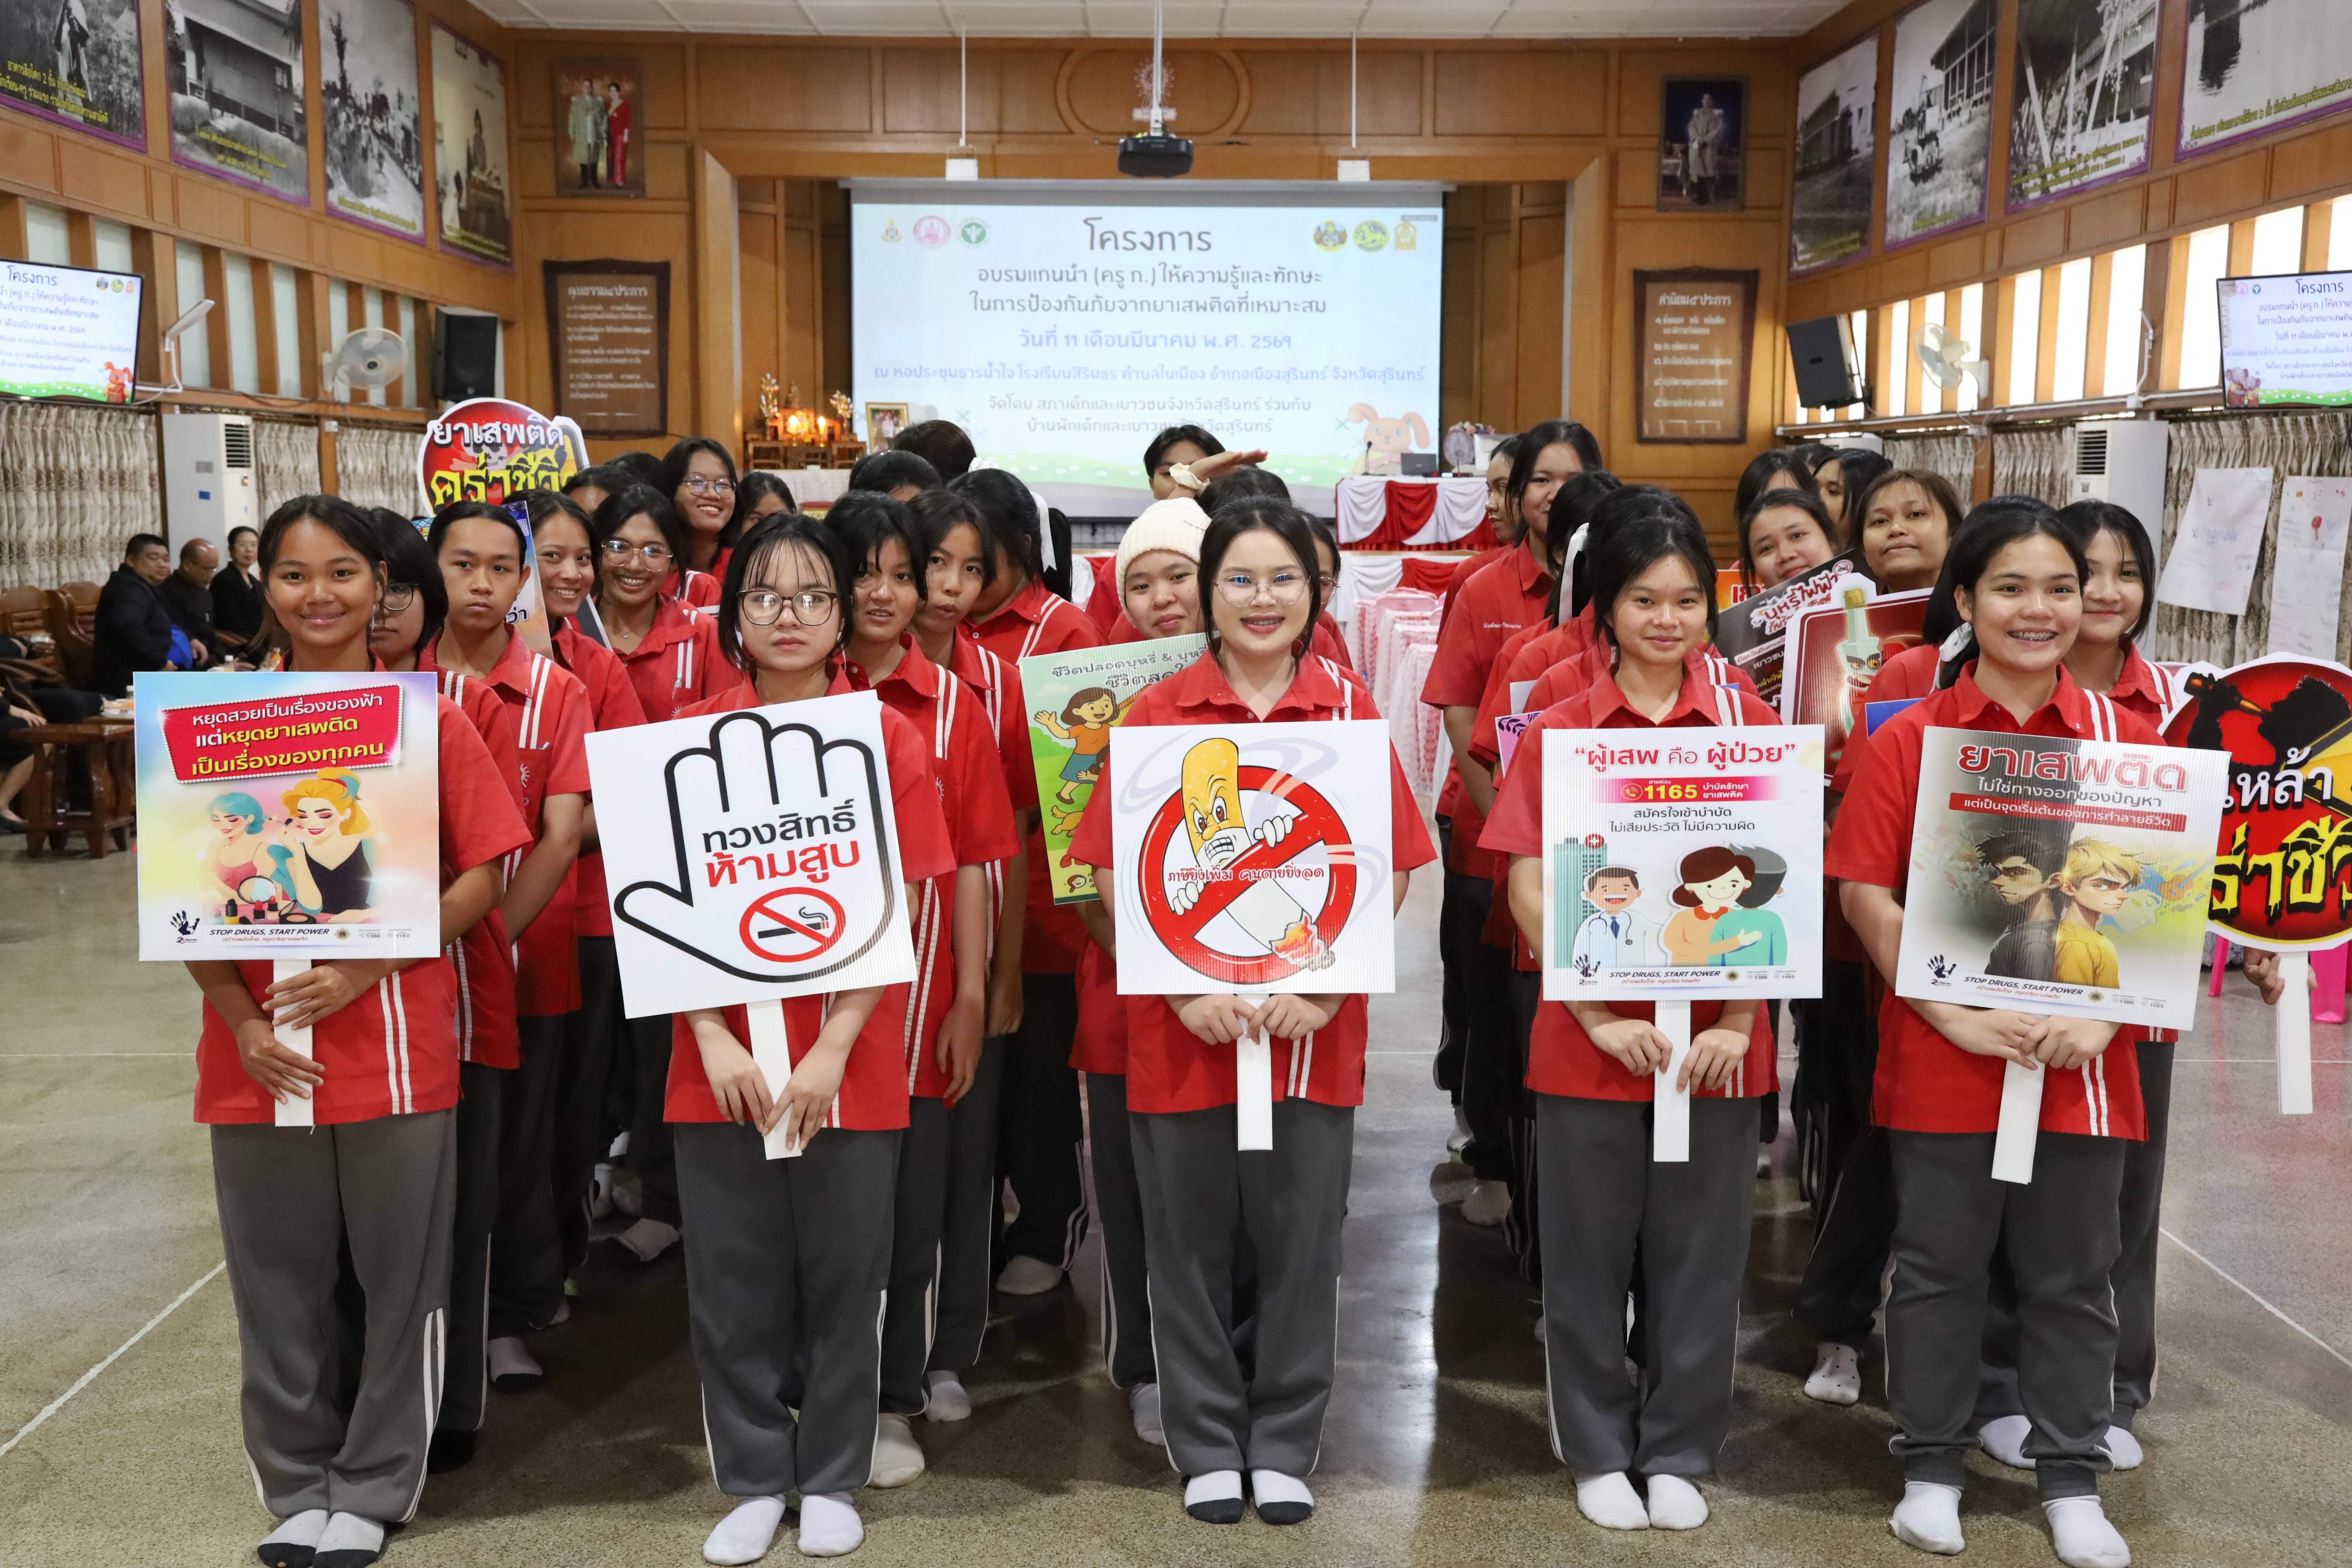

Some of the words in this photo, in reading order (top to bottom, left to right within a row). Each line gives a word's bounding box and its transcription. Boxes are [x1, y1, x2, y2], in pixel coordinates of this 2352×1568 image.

[1083, 217, 1212, 251] โครงการ
[8, 265, 58, 286] โครงการ
[978, 263, 1087, 283] อบรมแกนนำ
[1094, 267, 1125, 288] (ครู
[1158, 262, 1322, 290] ให้ความรู้และทักษะ
[2295, 279, 2344, 294] โครงการ
[970, 289, 1327, 313] ในการป้องกันภัยจากยาเสพติดที่เหมาะสม
[1019, 325, 1058, 348] วันที่
[1064, 334, 1078, 348] 11
[1084, 329, 1196, 348] เดือนมีนาคม
[1203, 335, 1244, 348] พ.ศ.
[874, 366, 888, 378] ณ
[893, 361, 1014, 382] หอประชุมธารน้ำใจ
[1017, 363, 1117, 380] โรงเรียนสิรินธร
[1122, 363, 1205, 381] ตำบลในเมือง
[1210, 365, 1329, 384] อำเภอเมืองสุรินทร์
[1331, 366, 1427, 384] จังหวัดสุรินทร์
[988, 393, 1032, 410] จัดโดย
[1037, 394, 1263, 415] สภาเด็กและเยาวชนจังหวัดสุรินทร์
[1264, 397, 1311, 411] ร่วมกับ
[433, 415, 564, 445] ยาเสพติด
[1052, 651, 1156, 677] ชีวิตปลอดบุหรี่
[193, 694, 383, 728] หยุดสวยเป็นเรื่องของฟ้า
[196, 716, 358, 747] แต่หยุดยาเสพติด
[192, 741, 384, 775] เป็นเรื่องของทุกคน
[1668, 747, 1698, 764] คือ
[1957, 743, 2188, 792] ยาเสพติด
[1644, 784, 1697, 799] 1165
[1978, 776, 2162, 808] ไม่ใช่ทางออกของปัญหา
[1634, 806, 1731, 818] สมัครใจเข้าบำบัด
[1963, 798, 2171, 827] แต่เป็นจุดเริ่มต้นของการทำลายชีวิต
[701, 798, 856, 853] ทวงสิทธิ์
[1609, 821, 1679, 833] ไม่เสียประวัติ
[1683, 819, 1755, 831] ไม่มีความผิด
[704, 841, 860, 888] ห้ามสูบ
[1168, 863, 1233, 882] ภาษียิ่งเพิ่ม
[1238, 862, 1324, 881] คนตายยิ่งลด
[1988, 979, 2019, 989] DRUGS,
[2022, 983, 2048, 992] START
[2050, 986, 2083, 995] POWER
